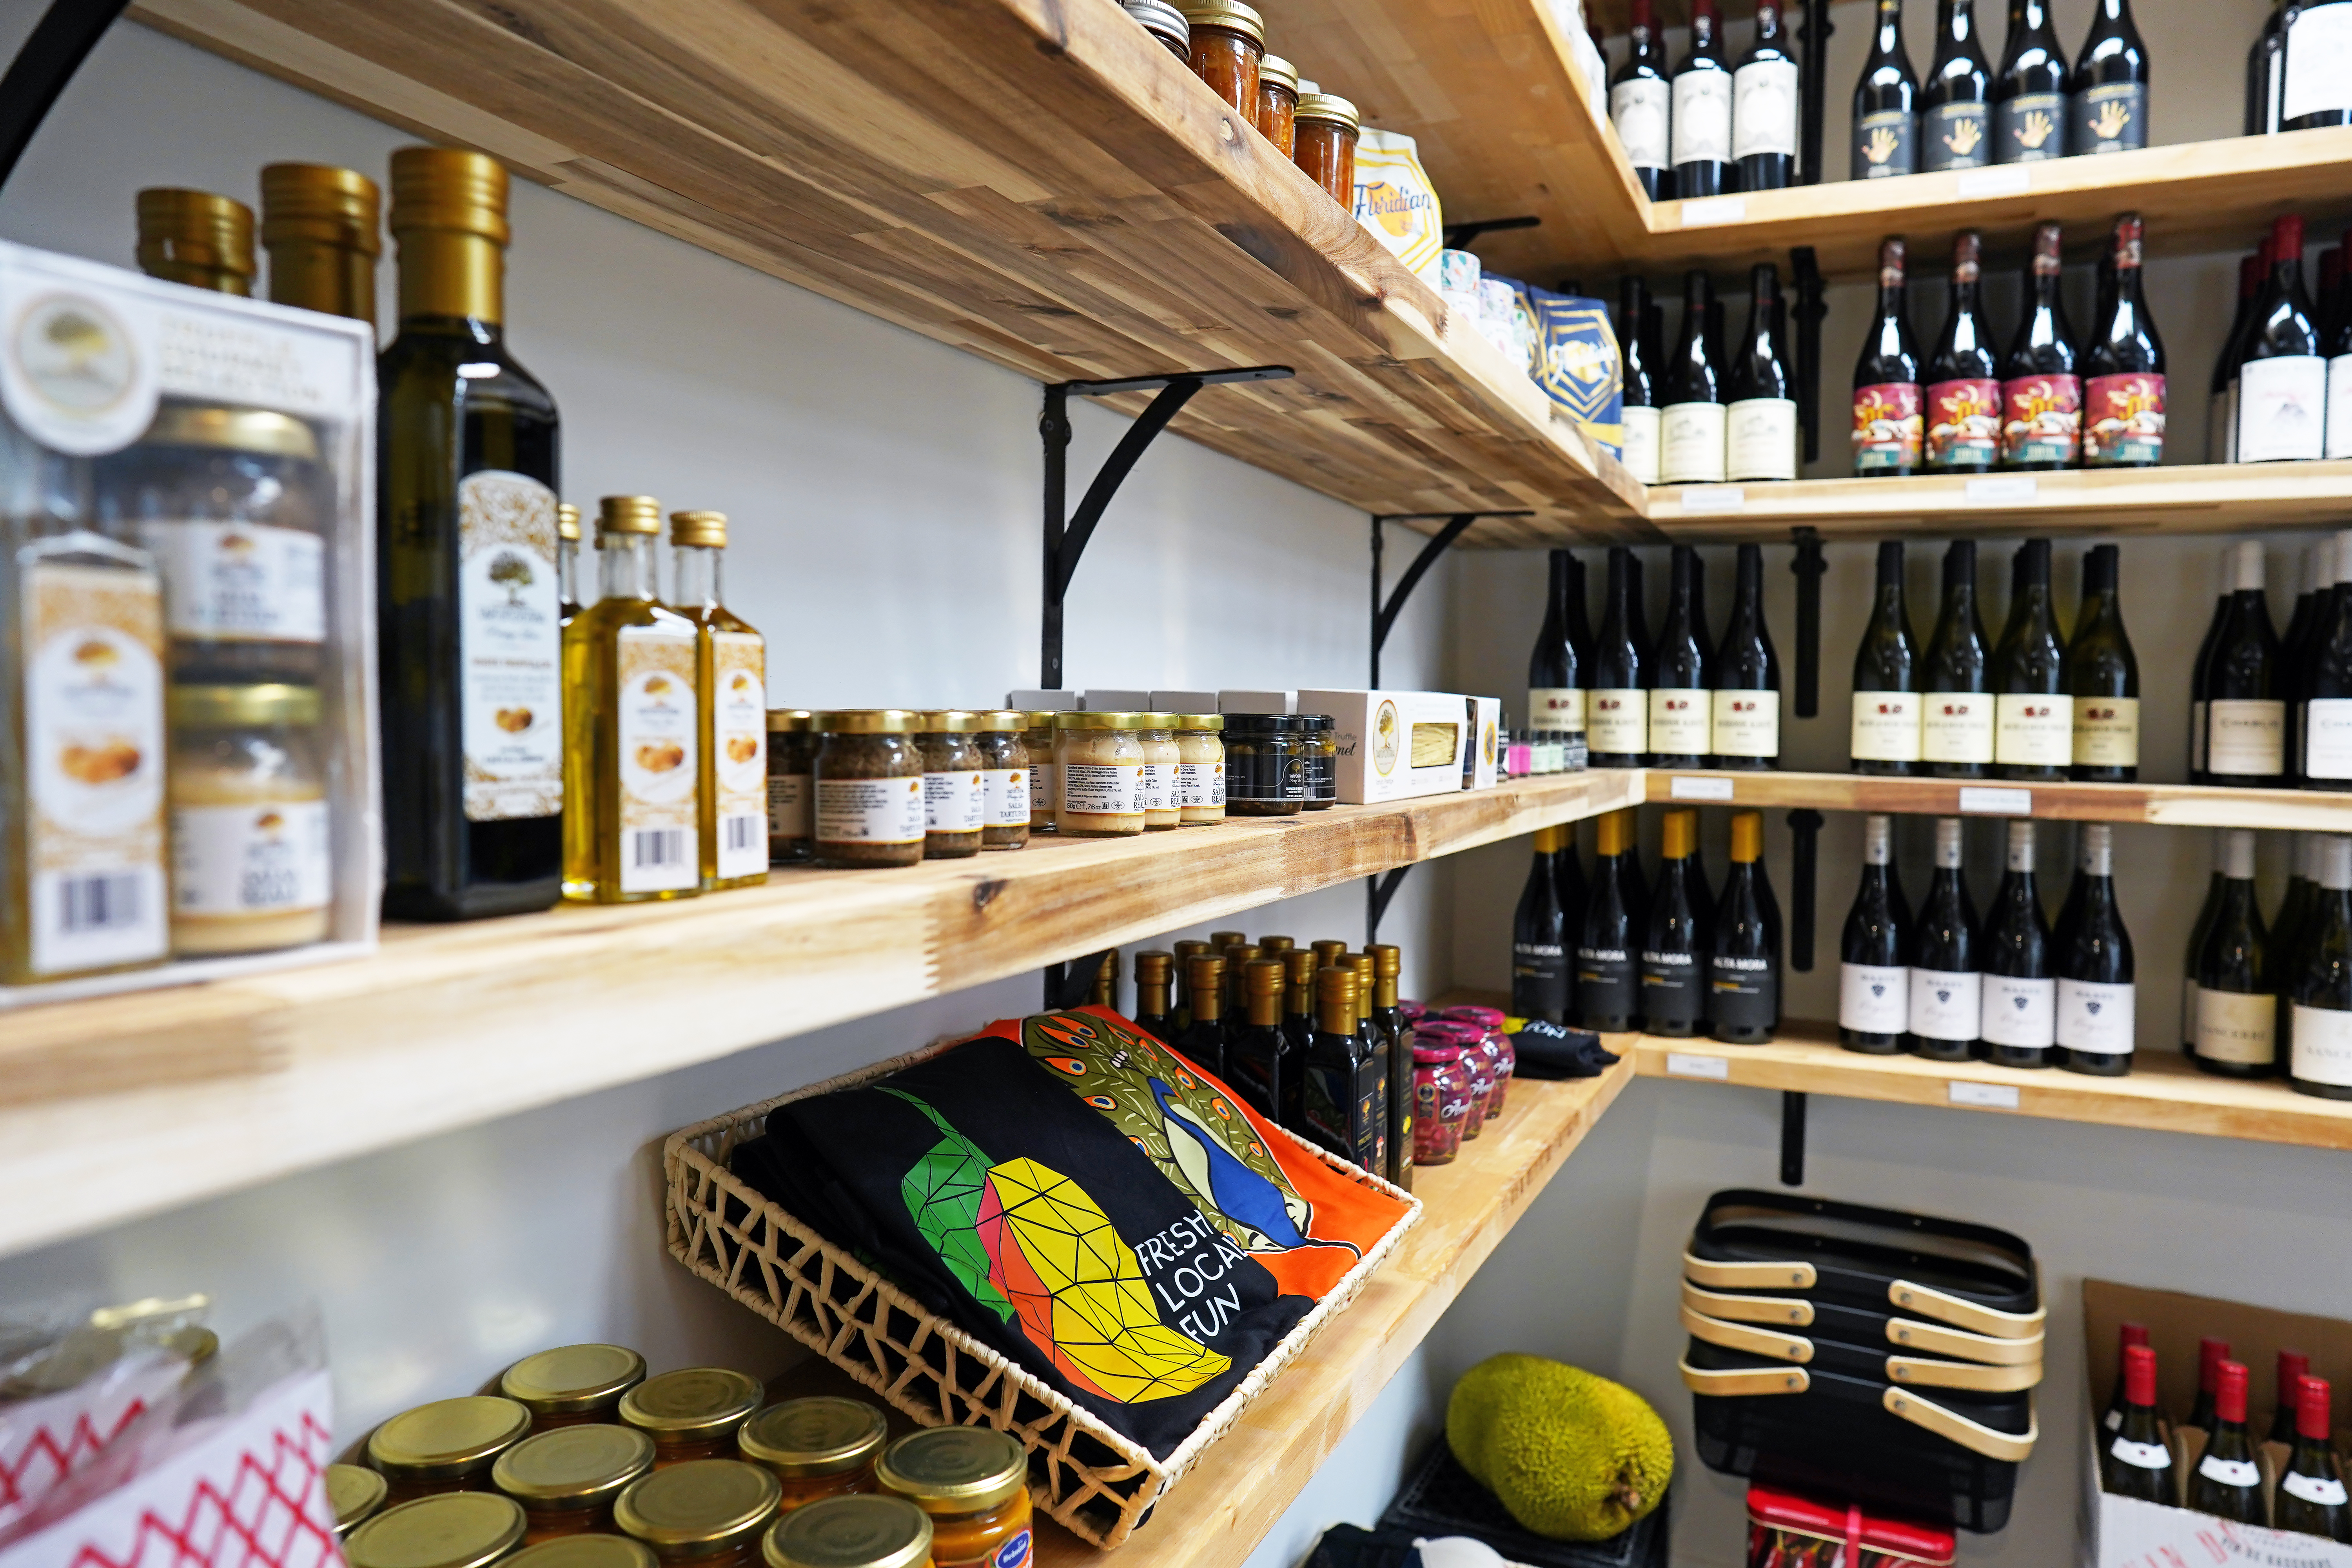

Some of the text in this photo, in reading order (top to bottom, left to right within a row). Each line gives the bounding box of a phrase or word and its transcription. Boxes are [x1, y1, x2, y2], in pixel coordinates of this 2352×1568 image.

[1354, 181, 1432, 221] Floridian
[1336, 742, 1357, 756] met
[1134, 1209, 1214, 1277] FRESH
[1155, 1237, 1249, 1312] LOCAL
[1179, 1283, 1240, 1345] FUN
